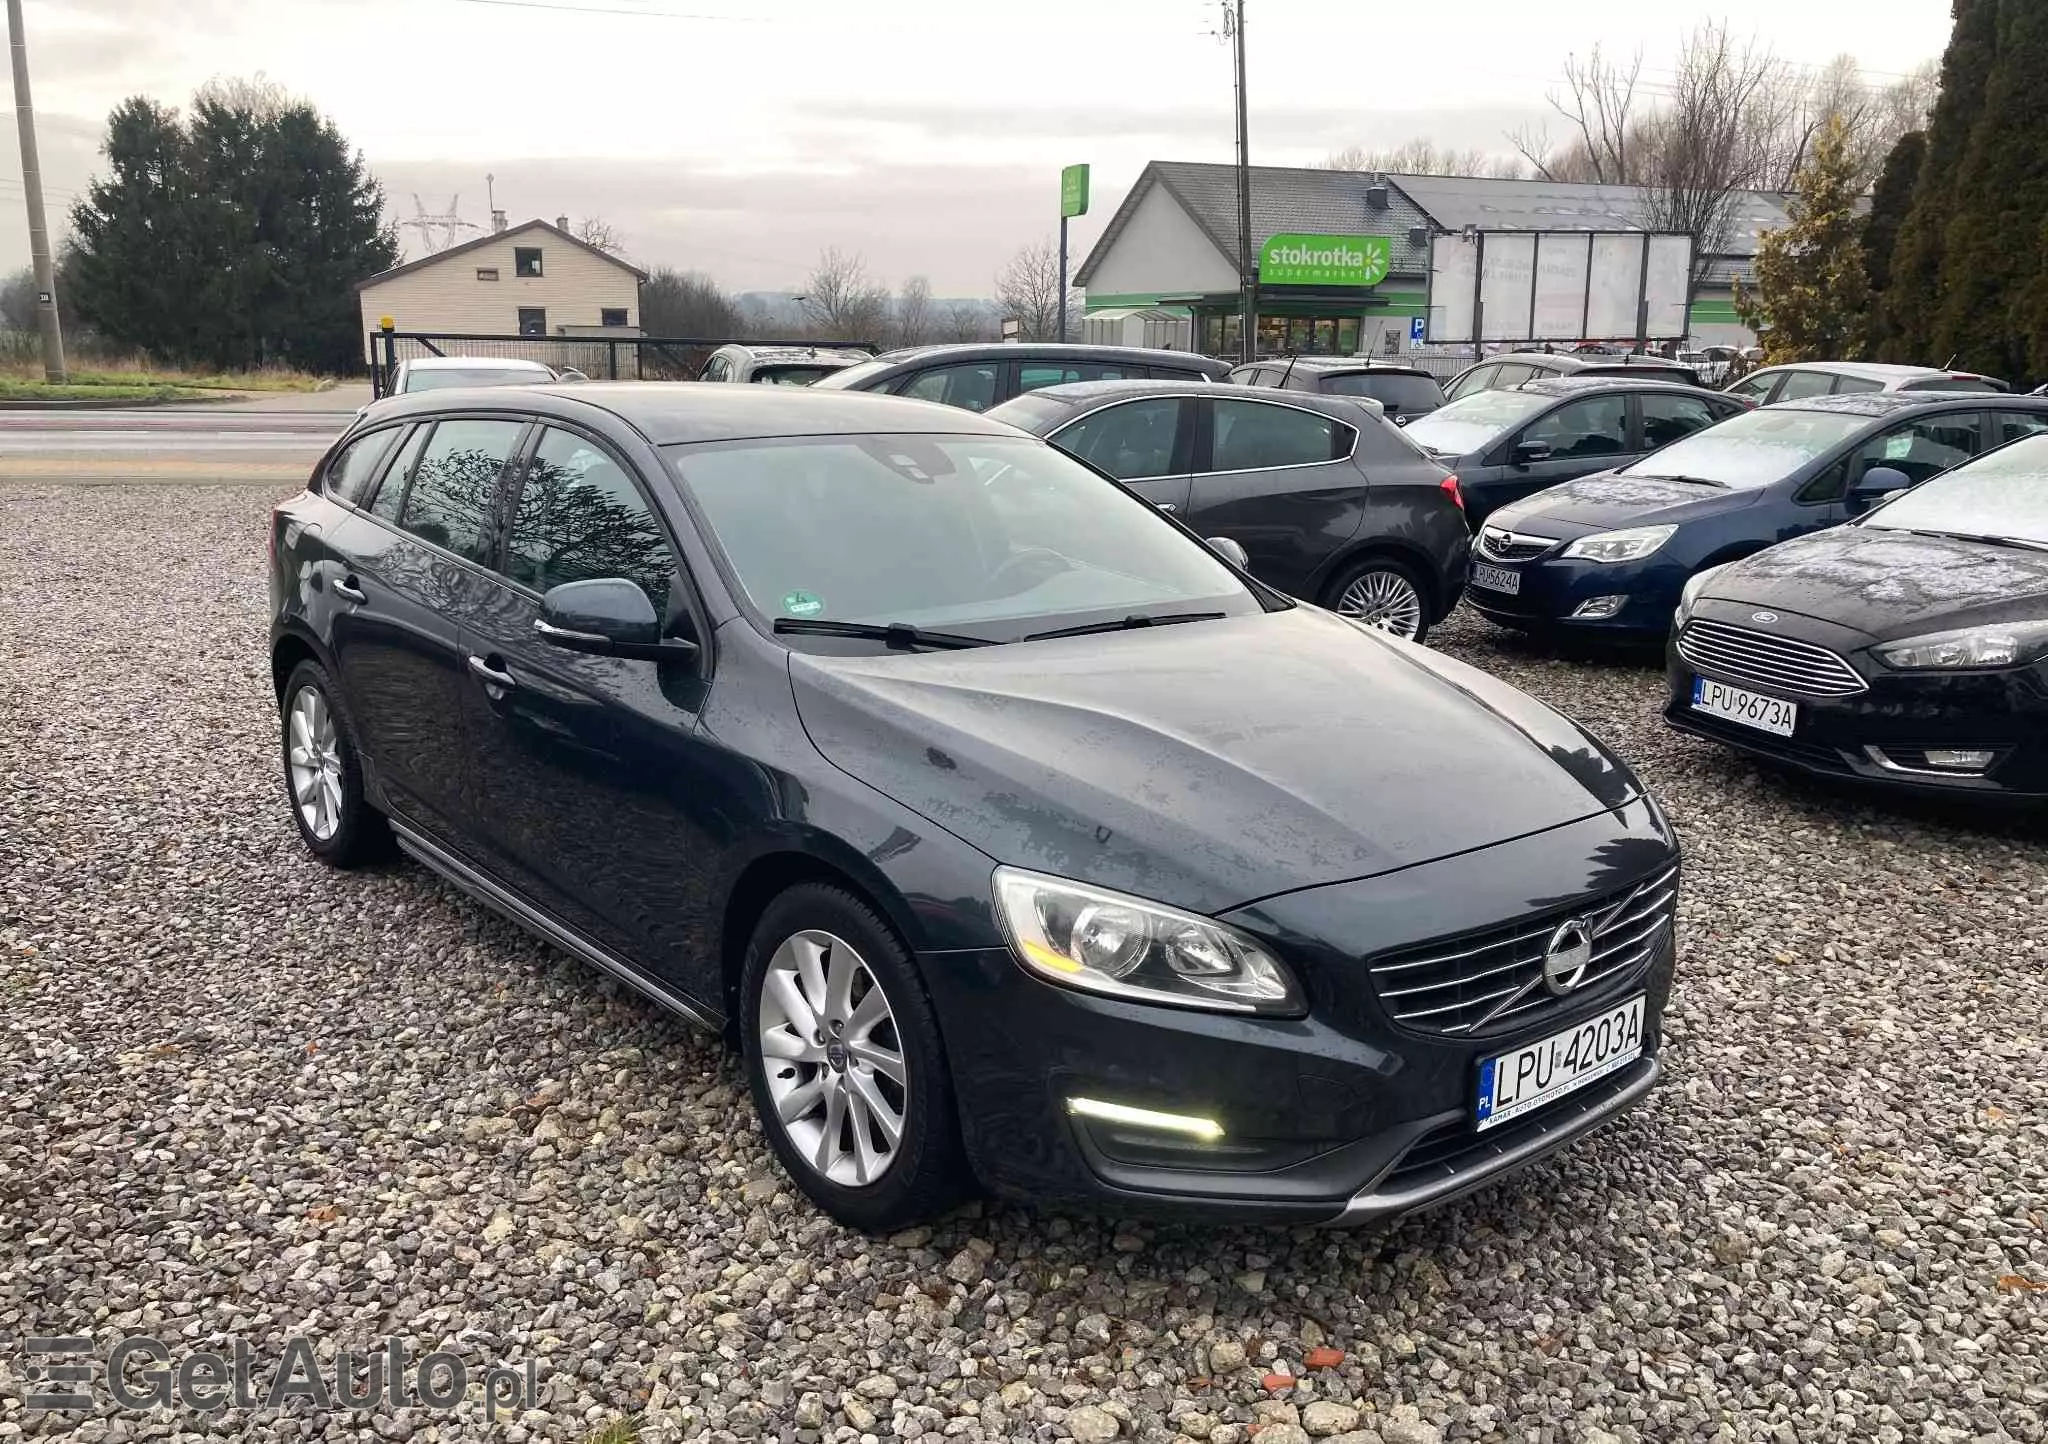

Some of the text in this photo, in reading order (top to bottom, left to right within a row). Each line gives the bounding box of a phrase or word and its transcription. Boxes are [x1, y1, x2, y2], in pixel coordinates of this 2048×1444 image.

[1269, 244, 1363, 266] stokrotka
[1415, 318, 1424, 332] P
[1490, 569, 1518, 590] 5624A
[1701, 682, 1734, 711] LPU
[1736, 693, 1792, 729] 9673A
[1496, 1003, 1638, 1108] LPU 4203A
[1479, 1096, 1490, 1110] PL
